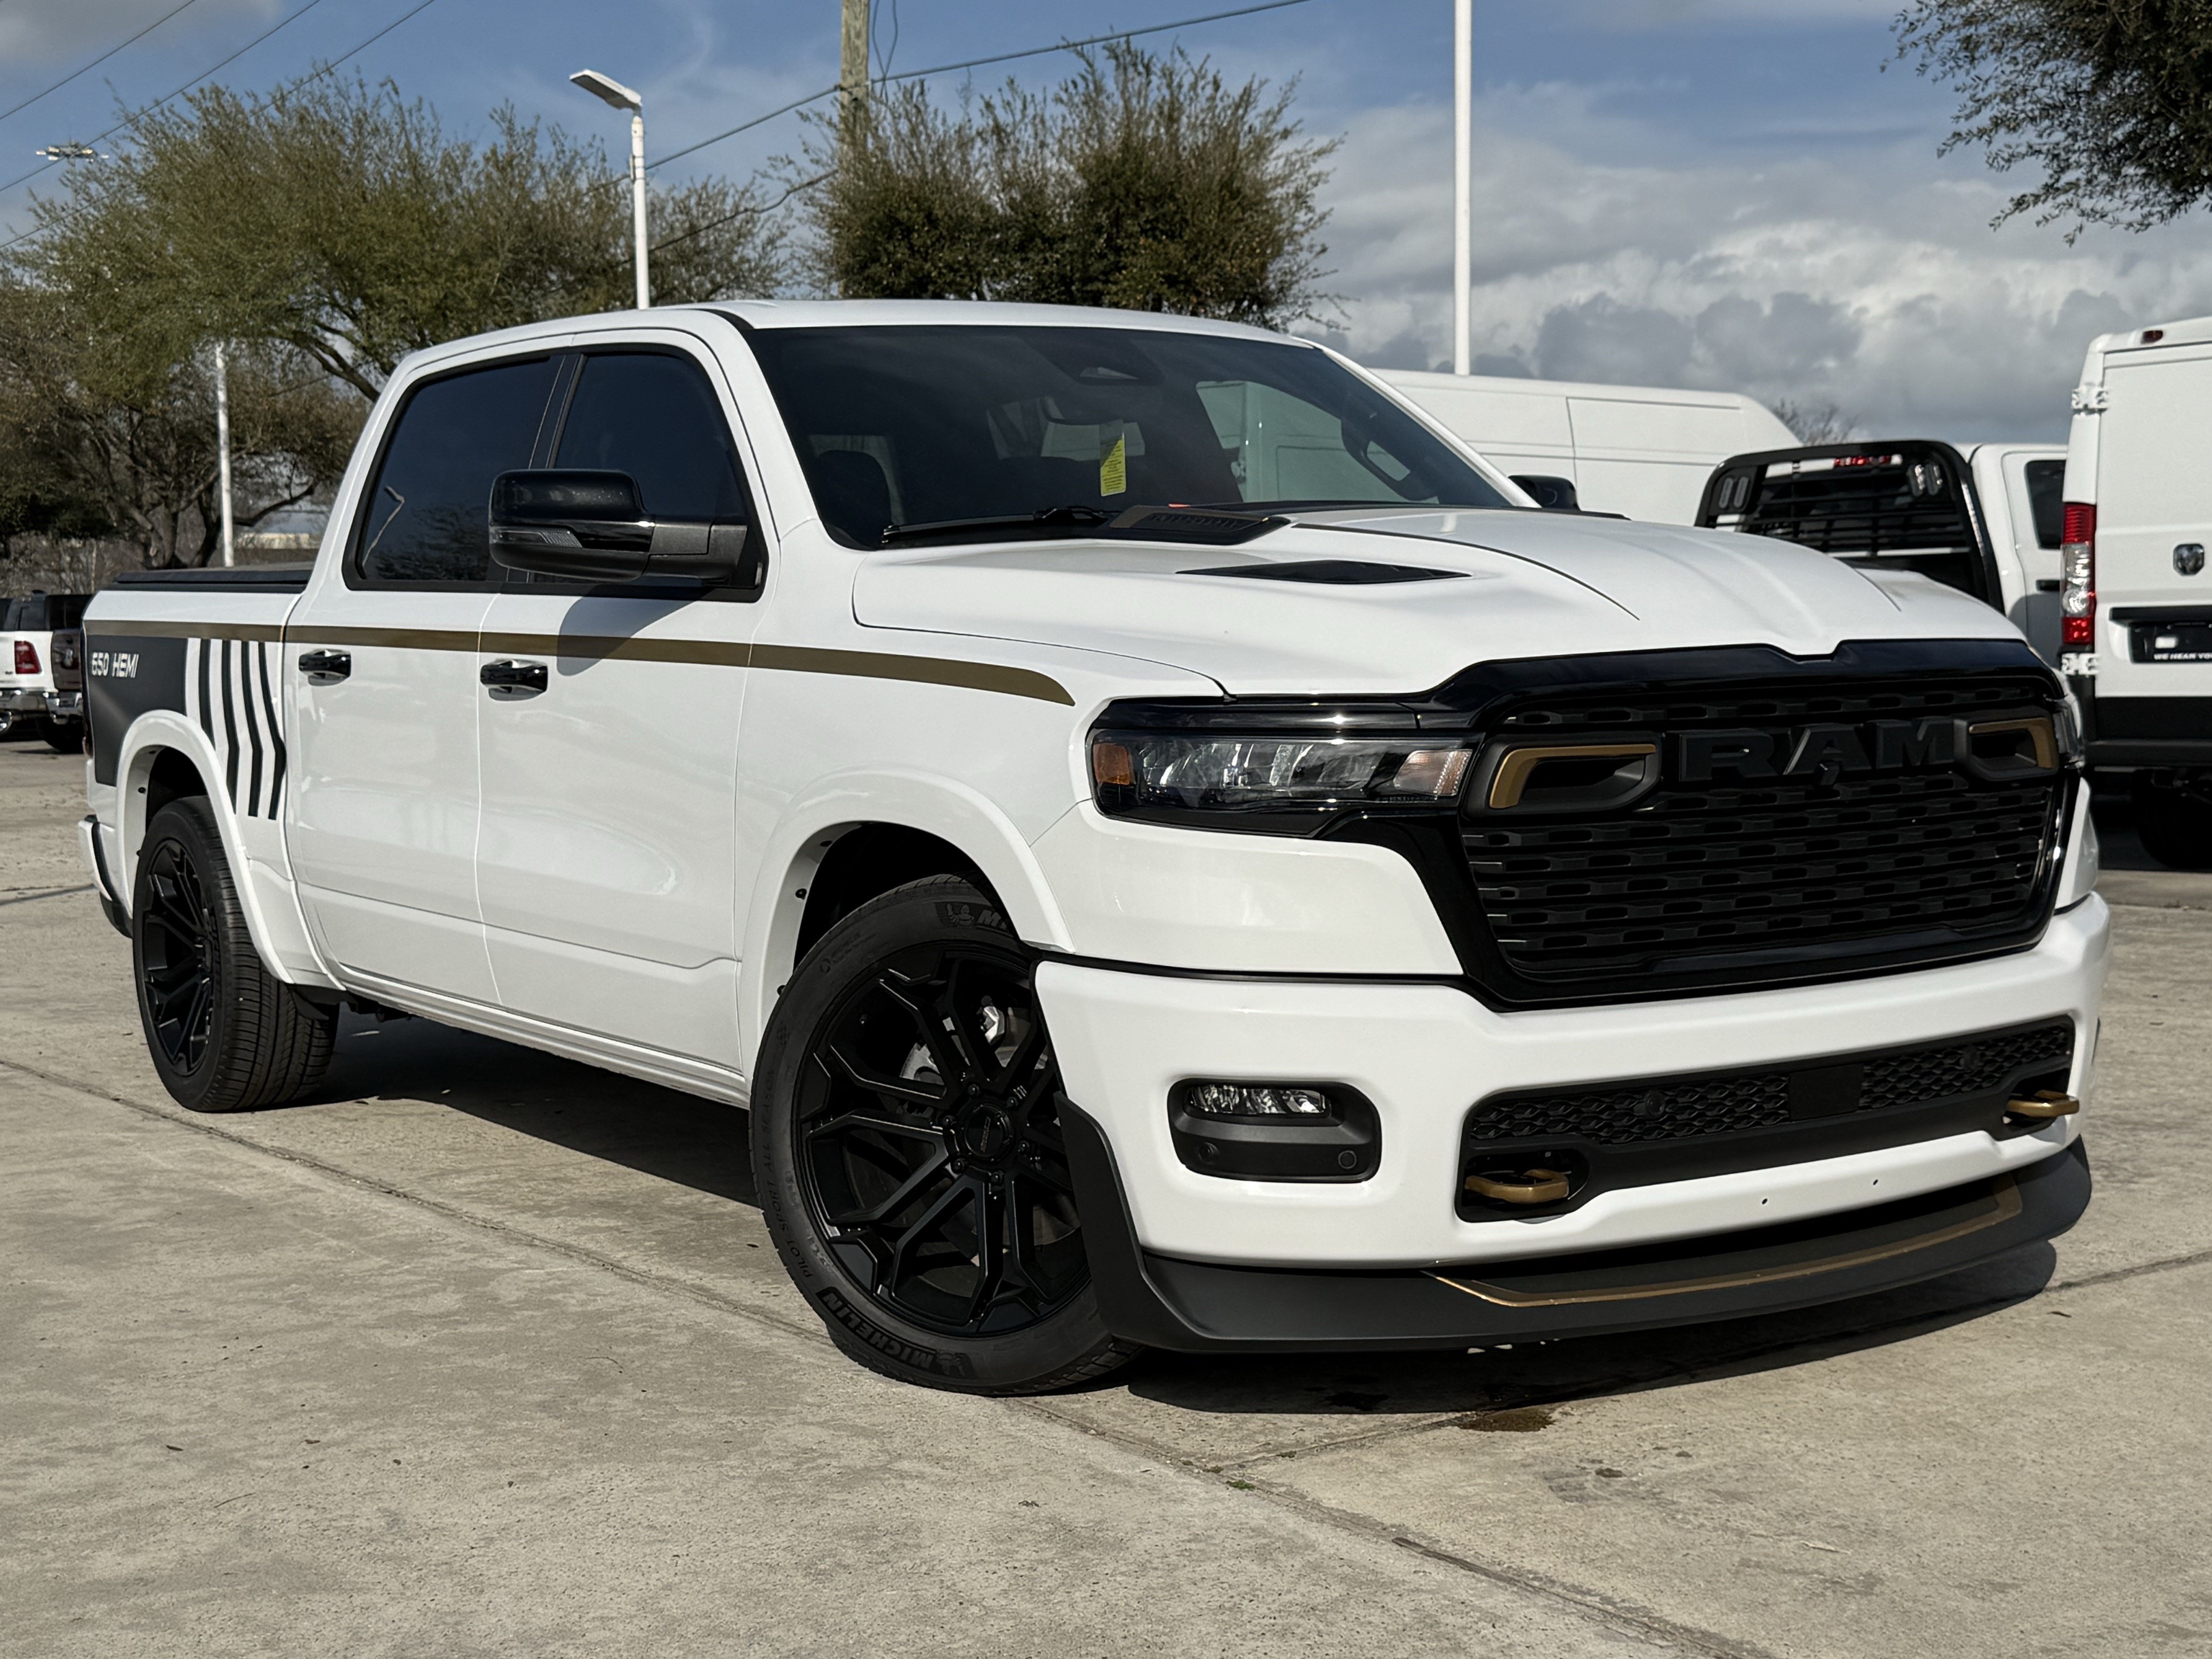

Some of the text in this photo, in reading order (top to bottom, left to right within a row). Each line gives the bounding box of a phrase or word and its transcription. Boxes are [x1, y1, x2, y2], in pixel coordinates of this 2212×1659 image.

[112, 653, 139, 678] HEMI
[1678, 718, 1956, 781] RAM
[768, 1182, 787, 1231] SPORT
[787, 1240, 812, 1278] PILOT
[823, 1292, 935, 1369] MICHELIN
